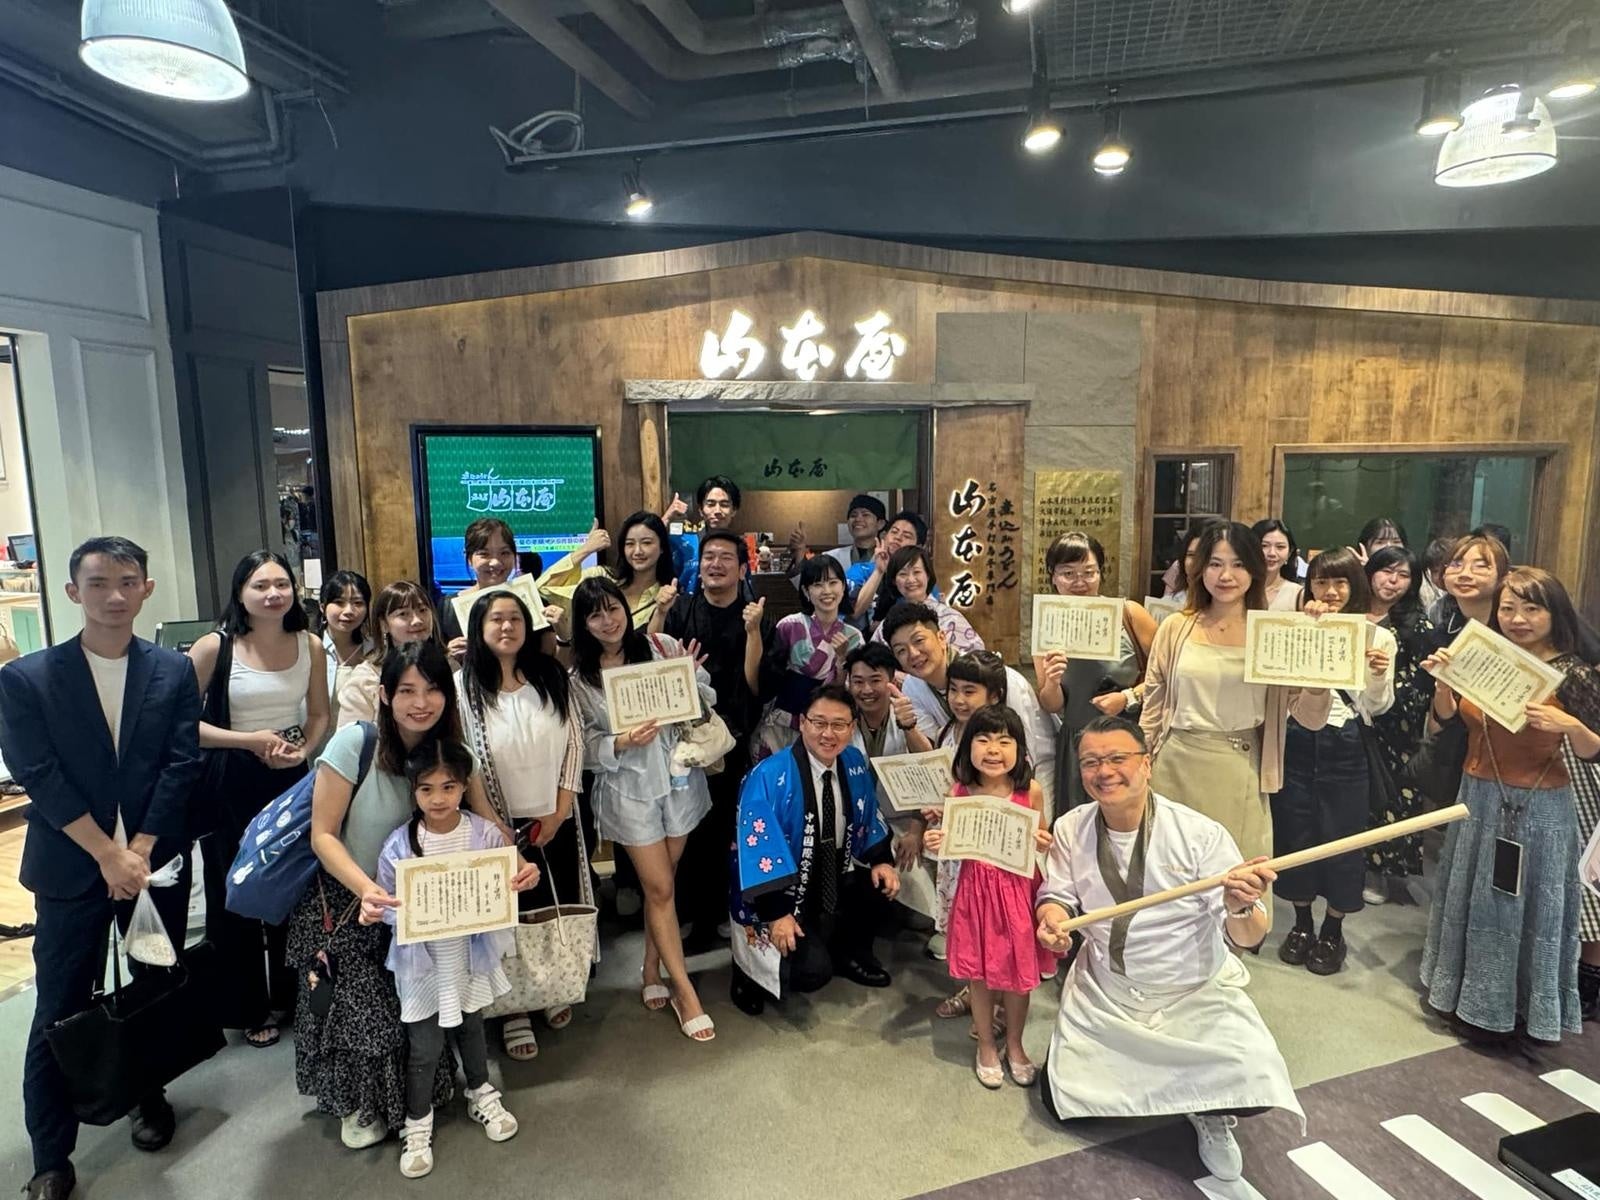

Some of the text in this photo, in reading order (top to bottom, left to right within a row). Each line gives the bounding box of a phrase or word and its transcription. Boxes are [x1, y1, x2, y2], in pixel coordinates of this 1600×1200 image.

[699, 309, 907, 381] 山本屋
[764, 457, 828, 478] 山本屋
[490, 486, 554, 508] 山本屋
[946, 478, 986, 608] 山本屋
